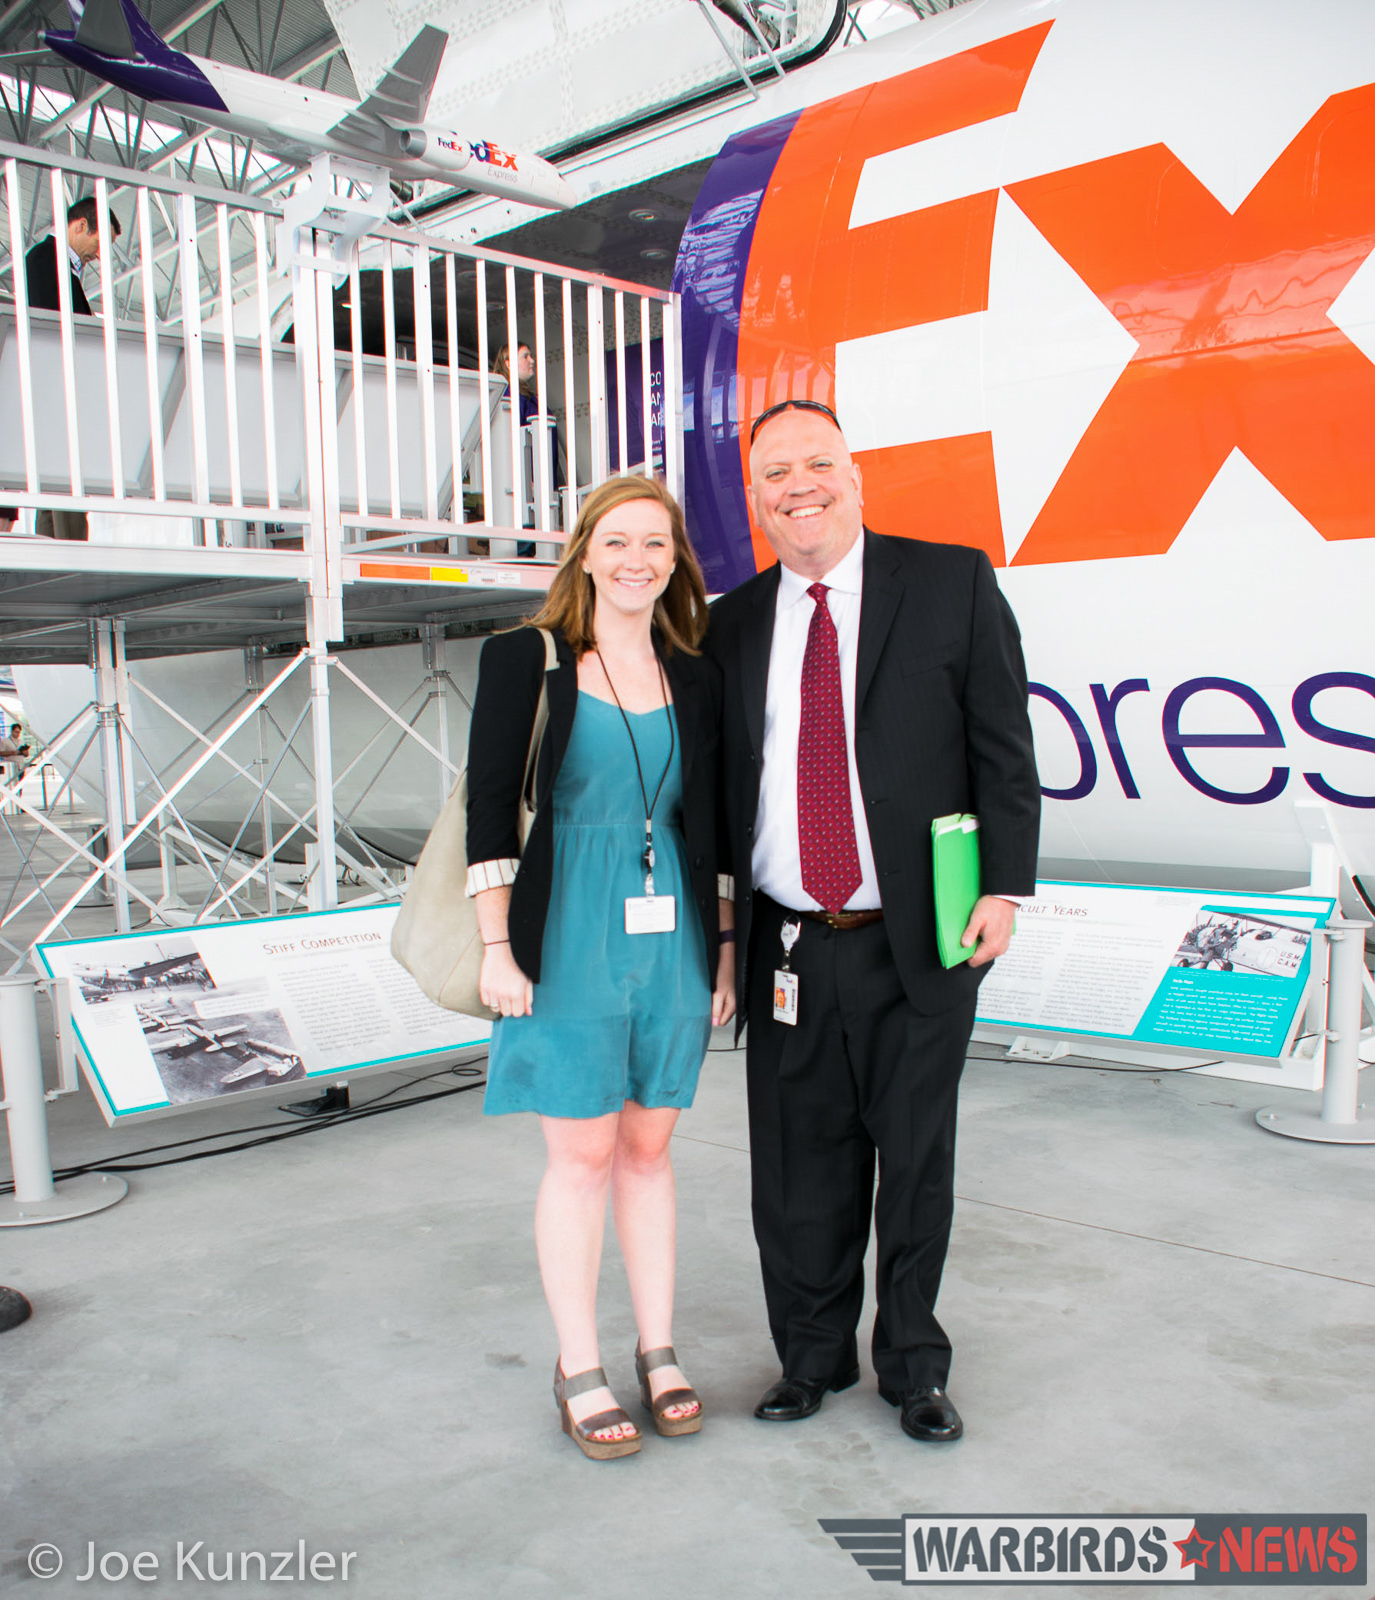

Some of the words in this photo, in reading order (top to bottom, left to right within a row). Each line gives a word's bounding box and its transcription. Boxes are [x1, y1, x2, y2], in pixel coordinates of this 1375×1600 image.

[437, 137, 463, 153] FedEx
[487, 165, 518, 183] Express
[1053, 904, 1089, 917] YEARS
[263, 943, 296, 955] STIFF
[301, 932, 382, 950] COMPETITION
